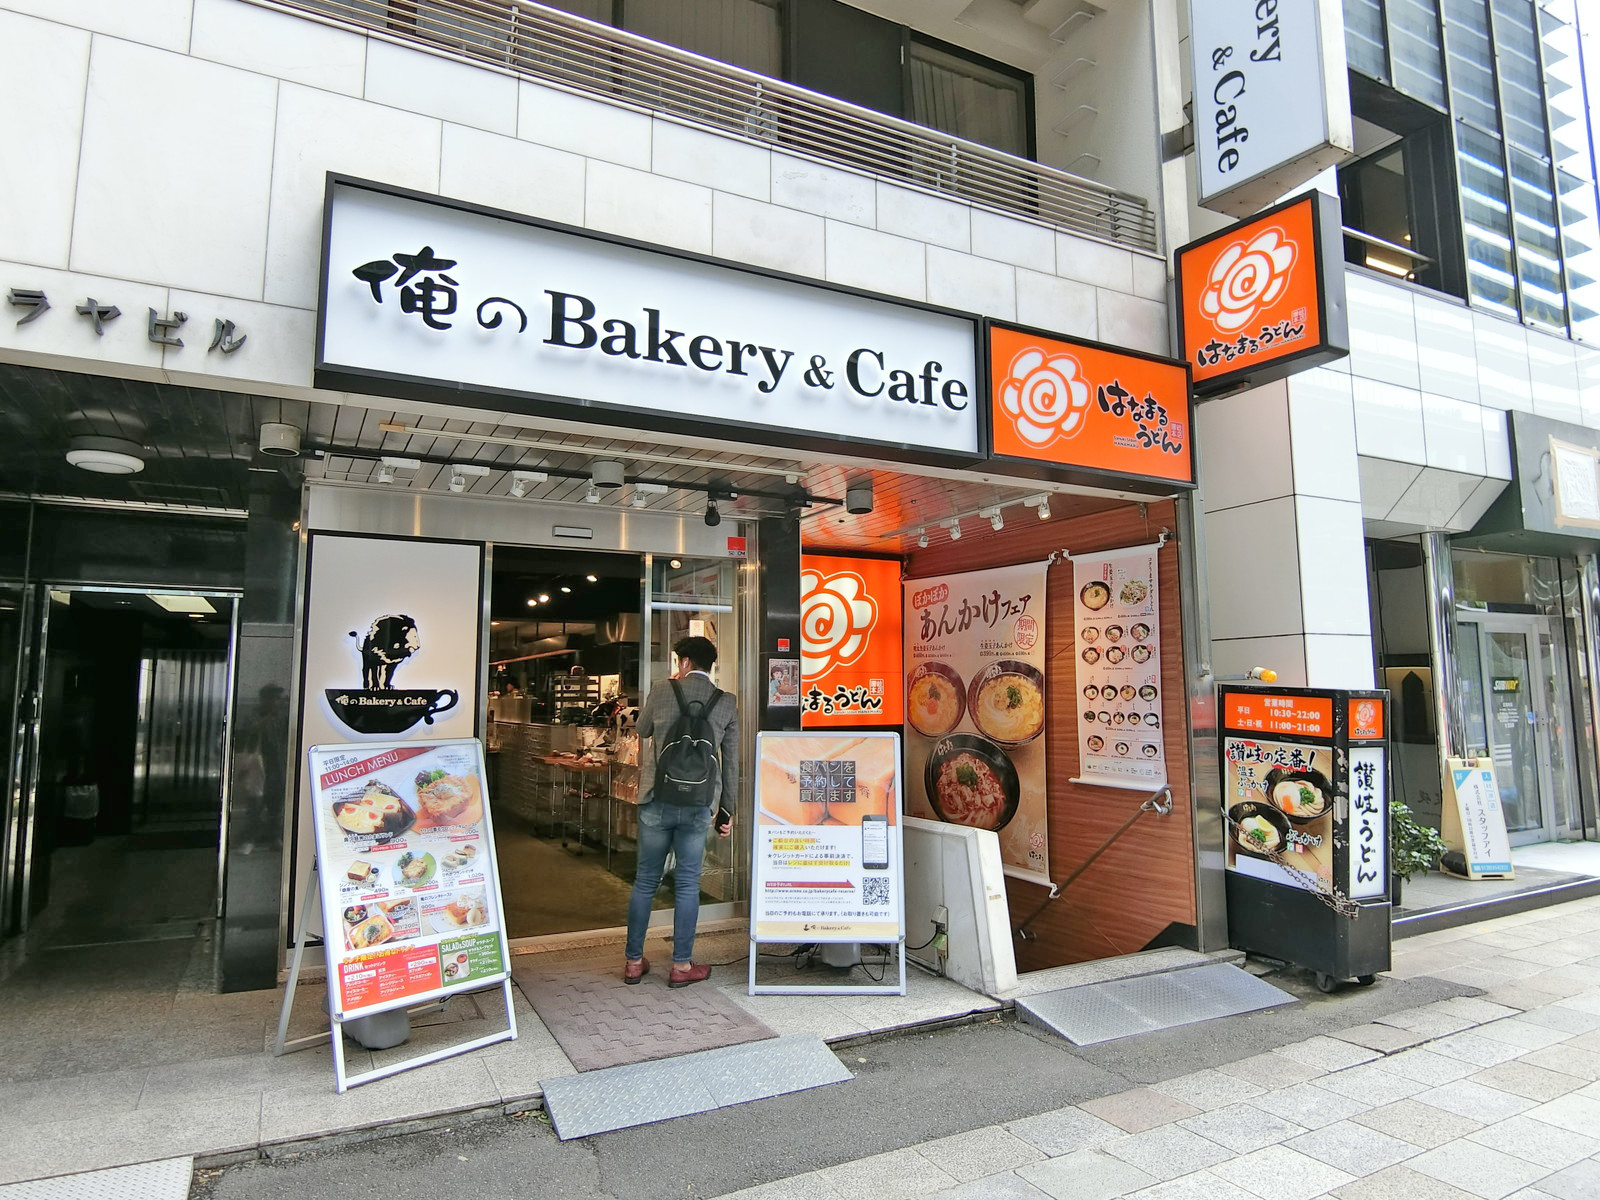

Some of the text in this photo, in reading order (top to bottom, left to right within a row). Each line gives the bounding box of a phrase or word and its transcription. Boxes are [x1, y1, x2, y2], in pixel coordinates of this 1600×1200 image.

[1250, 0, 1281, 62] ery
[1212, 46, 1249, 173] & Cafe
[352, 245, 968, 411] 俺の Bakery & Cafe
[1197, 321, 1304, 366] はなまるうどん
[1097, 379, 1168, 426] はなまる
[1136, 423, 1182, 454] うどん
[920, 589, 1032, 643] あんかけフェア
[1493, 680, 1519, 690] SUBWAY
[359, 697, 396, 707] Bakery
[403, 696, 428, 706] Cafe
[1237, 706, 1250, 715] 平日
[1264, 698, 1294, 709] 営業時間
[324, 751, 400, 786] LUNCH MENU
[800, 761, 855, 774] 食パンを
[1237, 766, 1256, 778] 温玉
[800, 775, 855, 788] 予約して
[1238, 777, 1269, 792] ぶっかけ
[800, 789, 855, 802] 買えます
[1353, 760, 1378, 884] 讃岐うどん
[1286, 829, 1322, 848] ぶっかけ
[1477, 809, 1491, 858] スタッフアイ
[343, 962, 364, 974] DRINK
